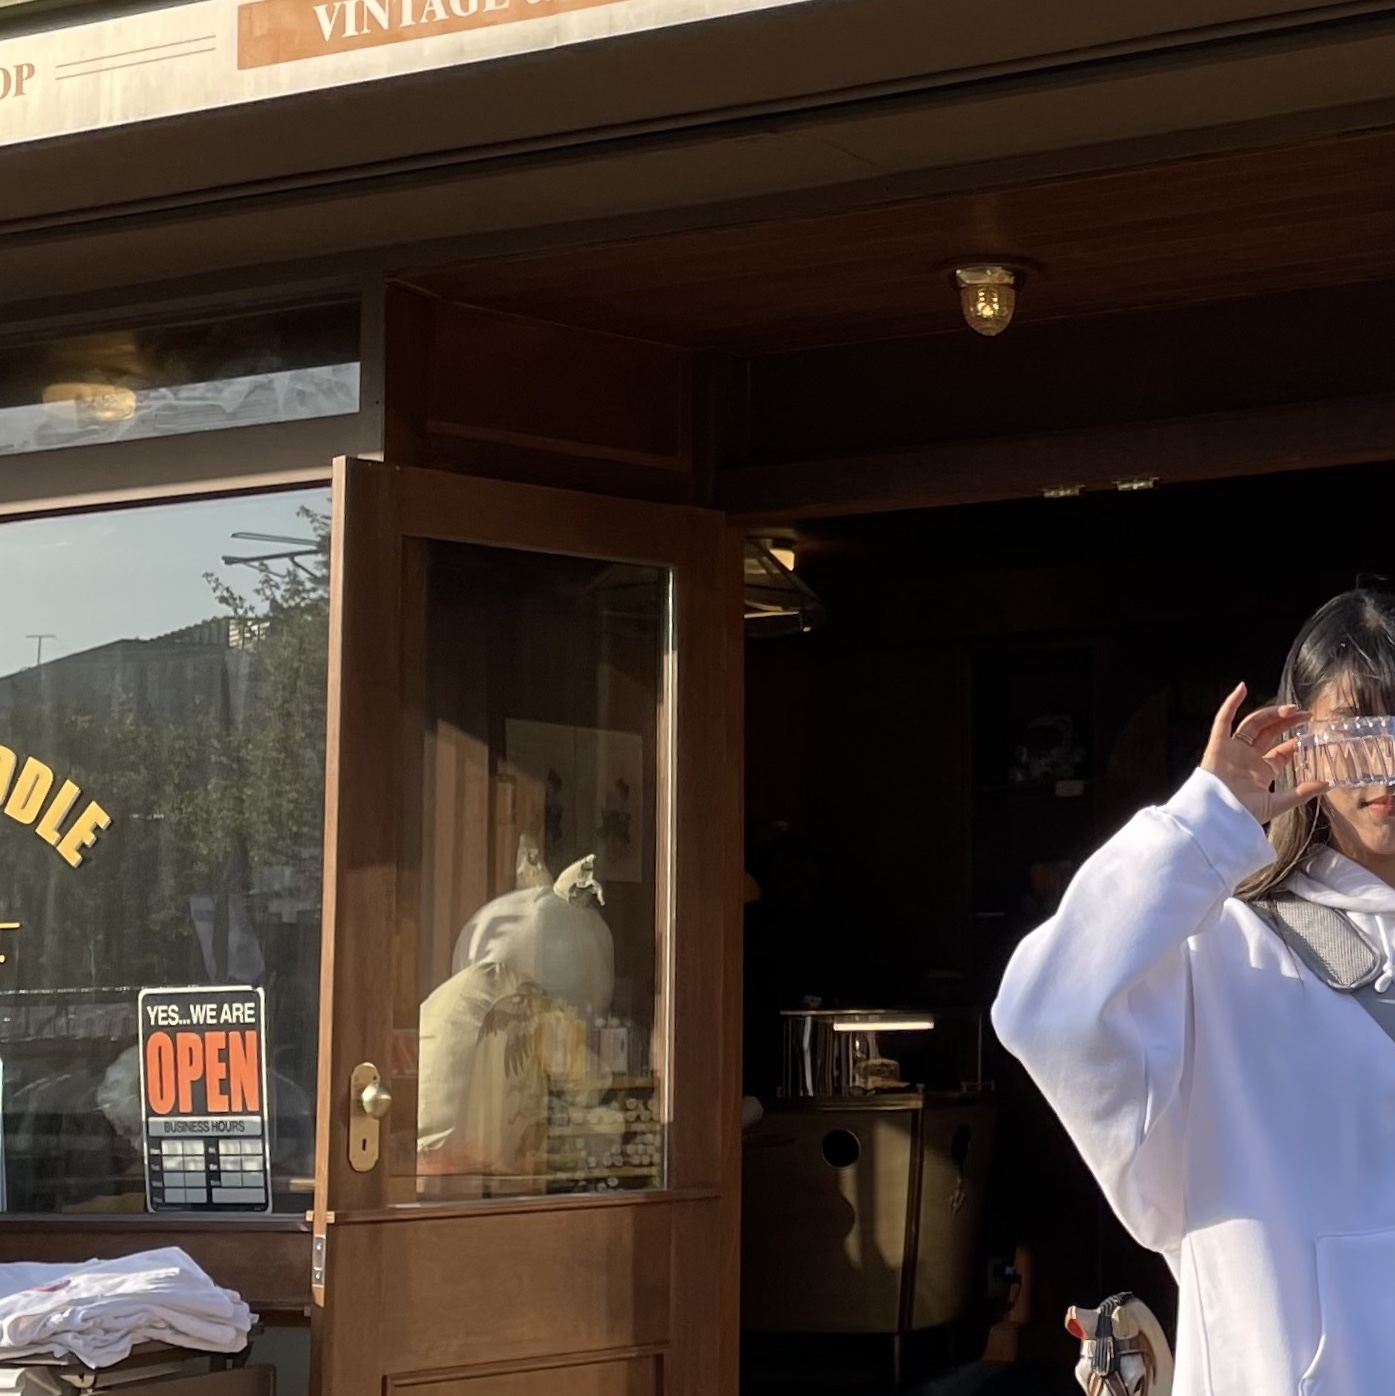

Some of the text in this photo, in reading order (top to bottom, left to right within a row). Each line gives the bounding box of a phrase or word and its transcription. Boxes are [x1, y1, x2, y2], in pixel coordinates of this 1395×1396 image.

[313, 0, 505, 42] VINTA
[220, 1003, 255, 1024] ARE
[147, 1030, 260, 1115] OPEN
[164, 1120, 245, 1133] BUSINESS HOURS
